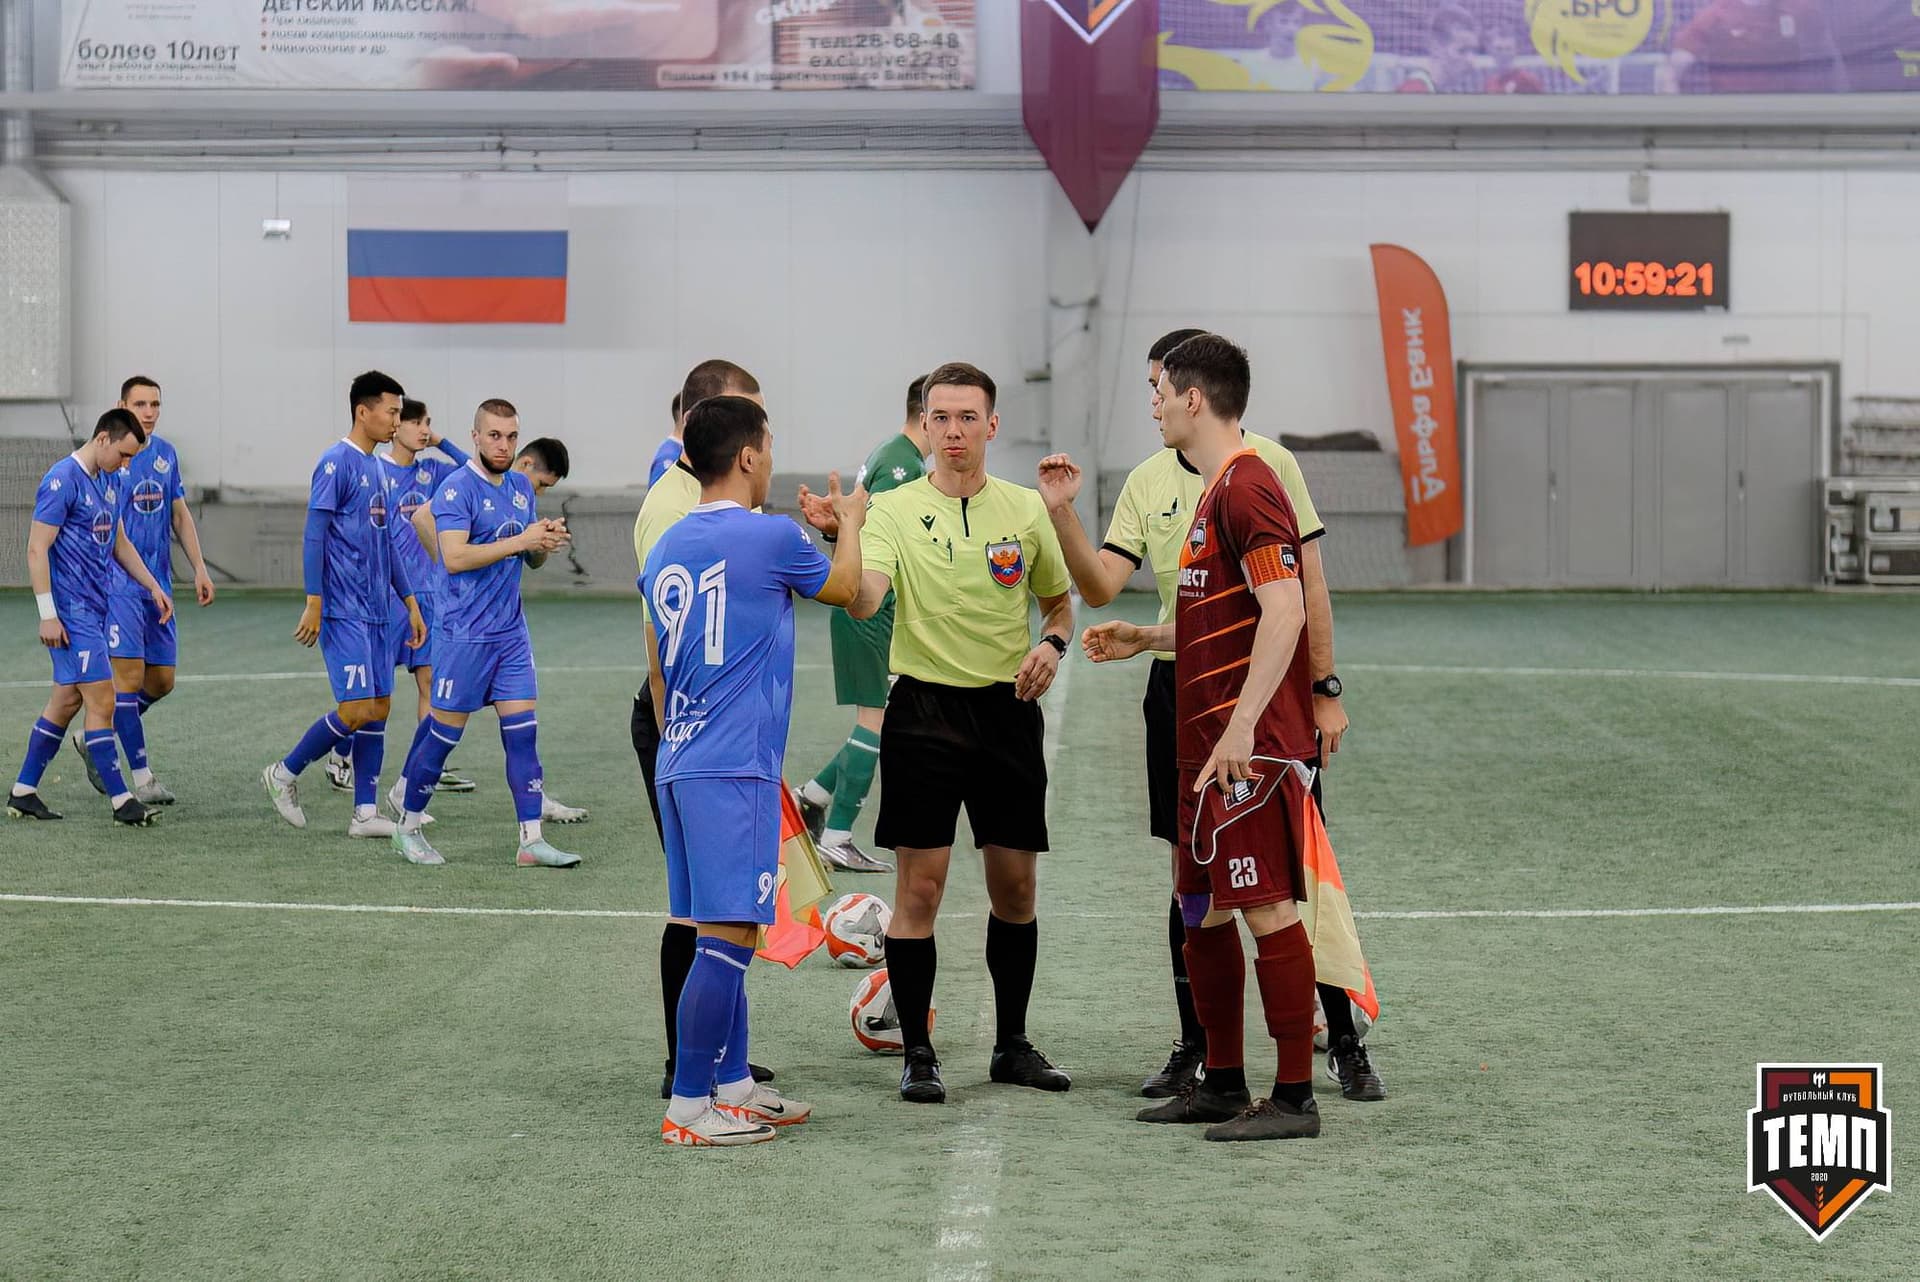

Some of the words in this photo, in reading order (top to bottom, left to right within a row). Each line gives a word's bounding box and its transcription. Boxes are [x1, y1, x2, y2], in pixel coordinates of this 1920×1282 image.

[78, 38, 156, 60] более
[1574, 261, 1714, 296] 10:59:21
[652, 558, 728, 667] 91
[108, 624, 121, 649] 5
[78, 650, 91, 674] 7
[343, 664, 367, 690] 71
[436, 677, 454, 699] 11
[1228, 856, 1259, 889] 23
